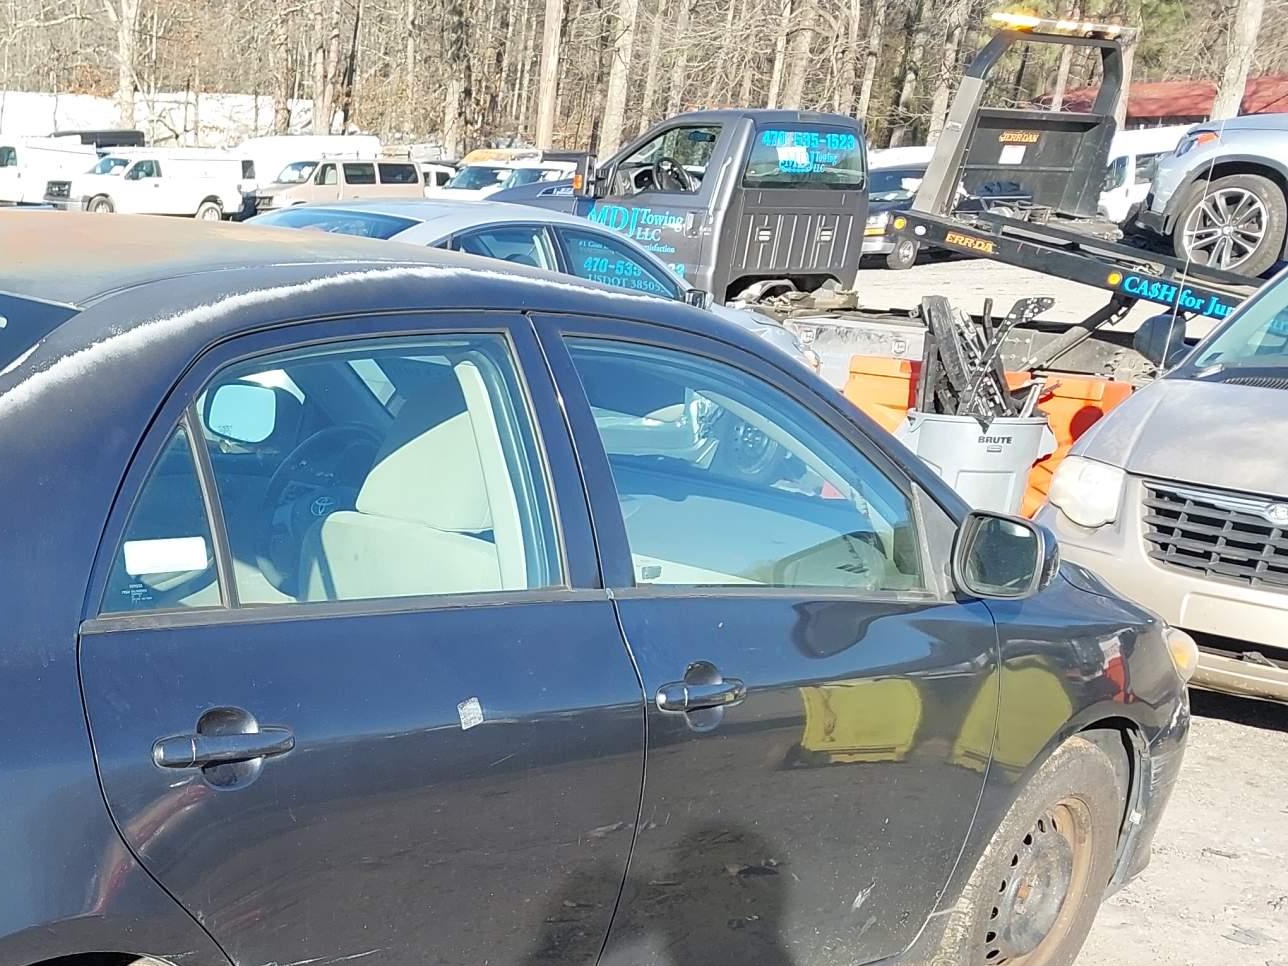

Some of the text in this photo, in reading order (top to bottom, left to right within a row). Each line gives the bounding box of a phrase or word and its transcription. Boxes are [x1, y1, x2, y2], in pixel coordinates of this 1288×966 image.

[588, 205, 639, 238] MDJ
[640, 208, 685, 232] Towing
[636, 227, 662, 241] LLC
[1124, 276, 1177, 302] CA$H
[1178, 289, 1205, 310] for
[977, 436, 1013, 445] BRUTE
